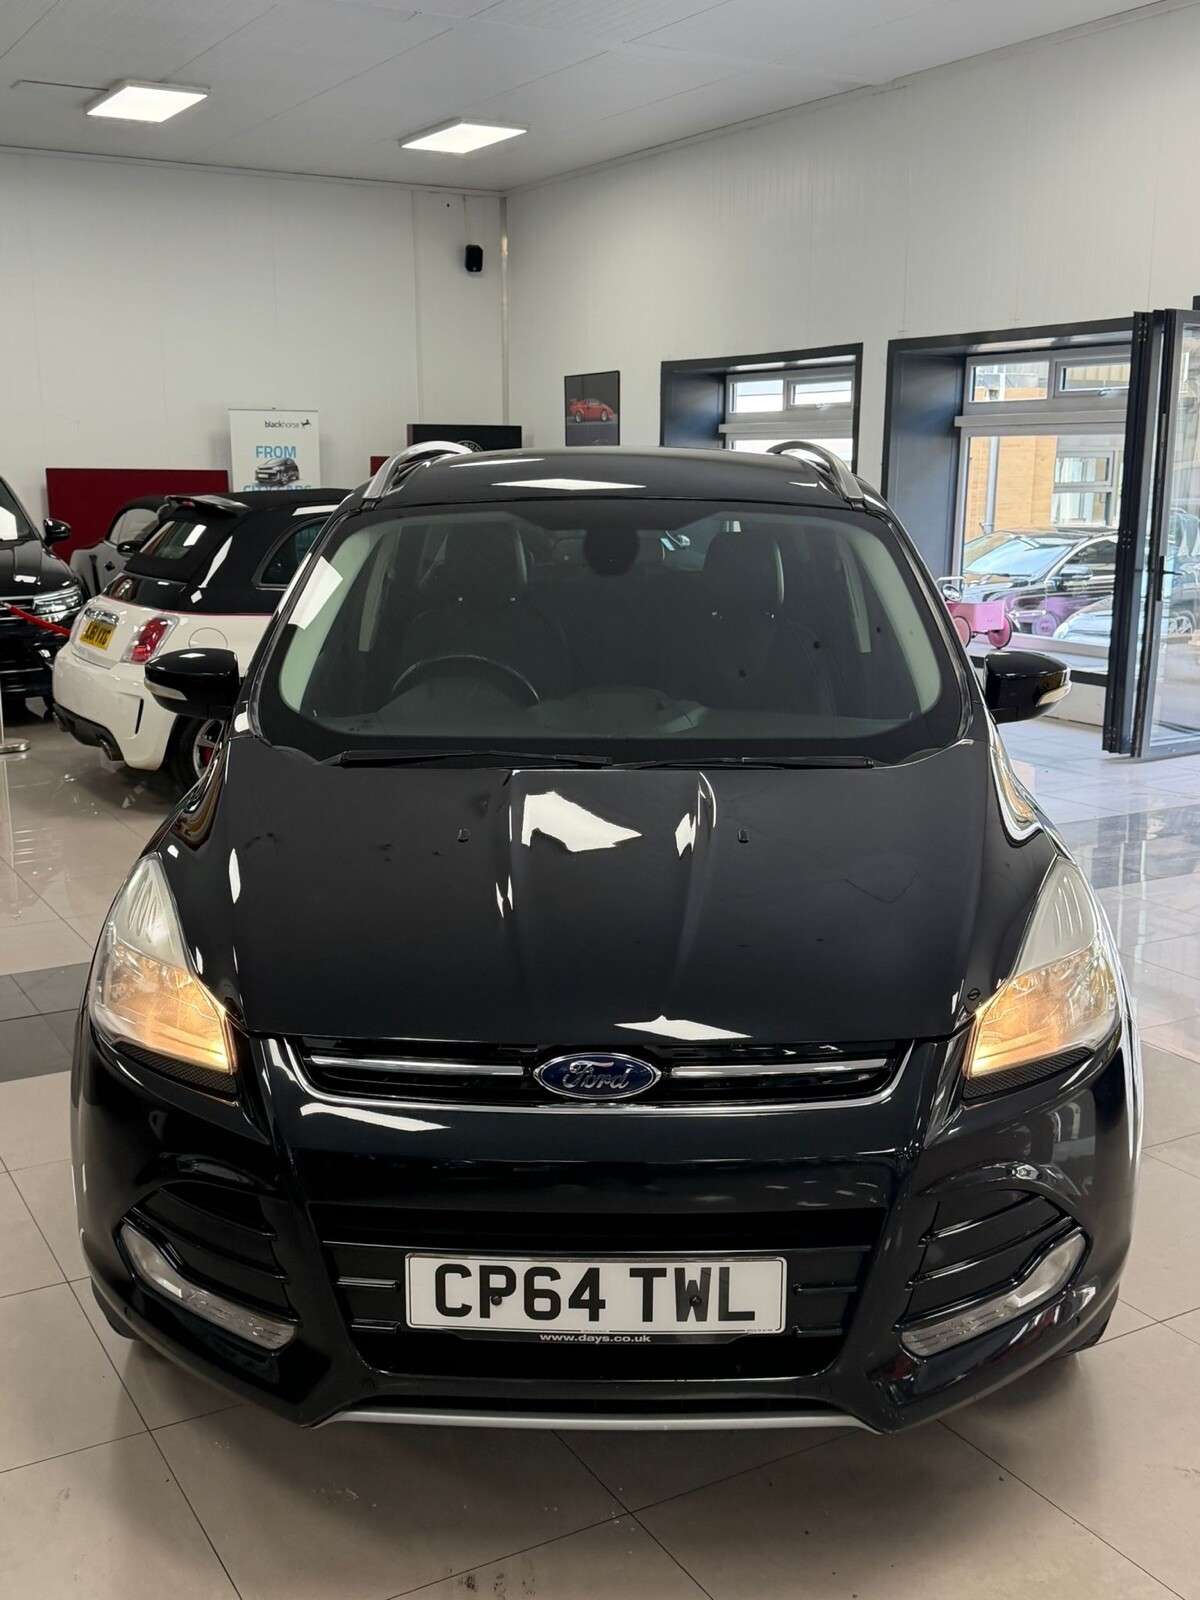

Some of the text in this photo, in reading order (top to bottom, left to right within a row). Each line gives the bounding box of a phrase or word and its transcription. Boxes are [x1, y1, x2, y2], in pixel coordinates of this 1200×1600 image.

[256, 446, 297, 458] FROM
[562, 1060, 634, 1089] Ford
[435, 1263, 756, 1322] CP64 TWL
[540, 1333, 652, 1344] www.days.co.uk
